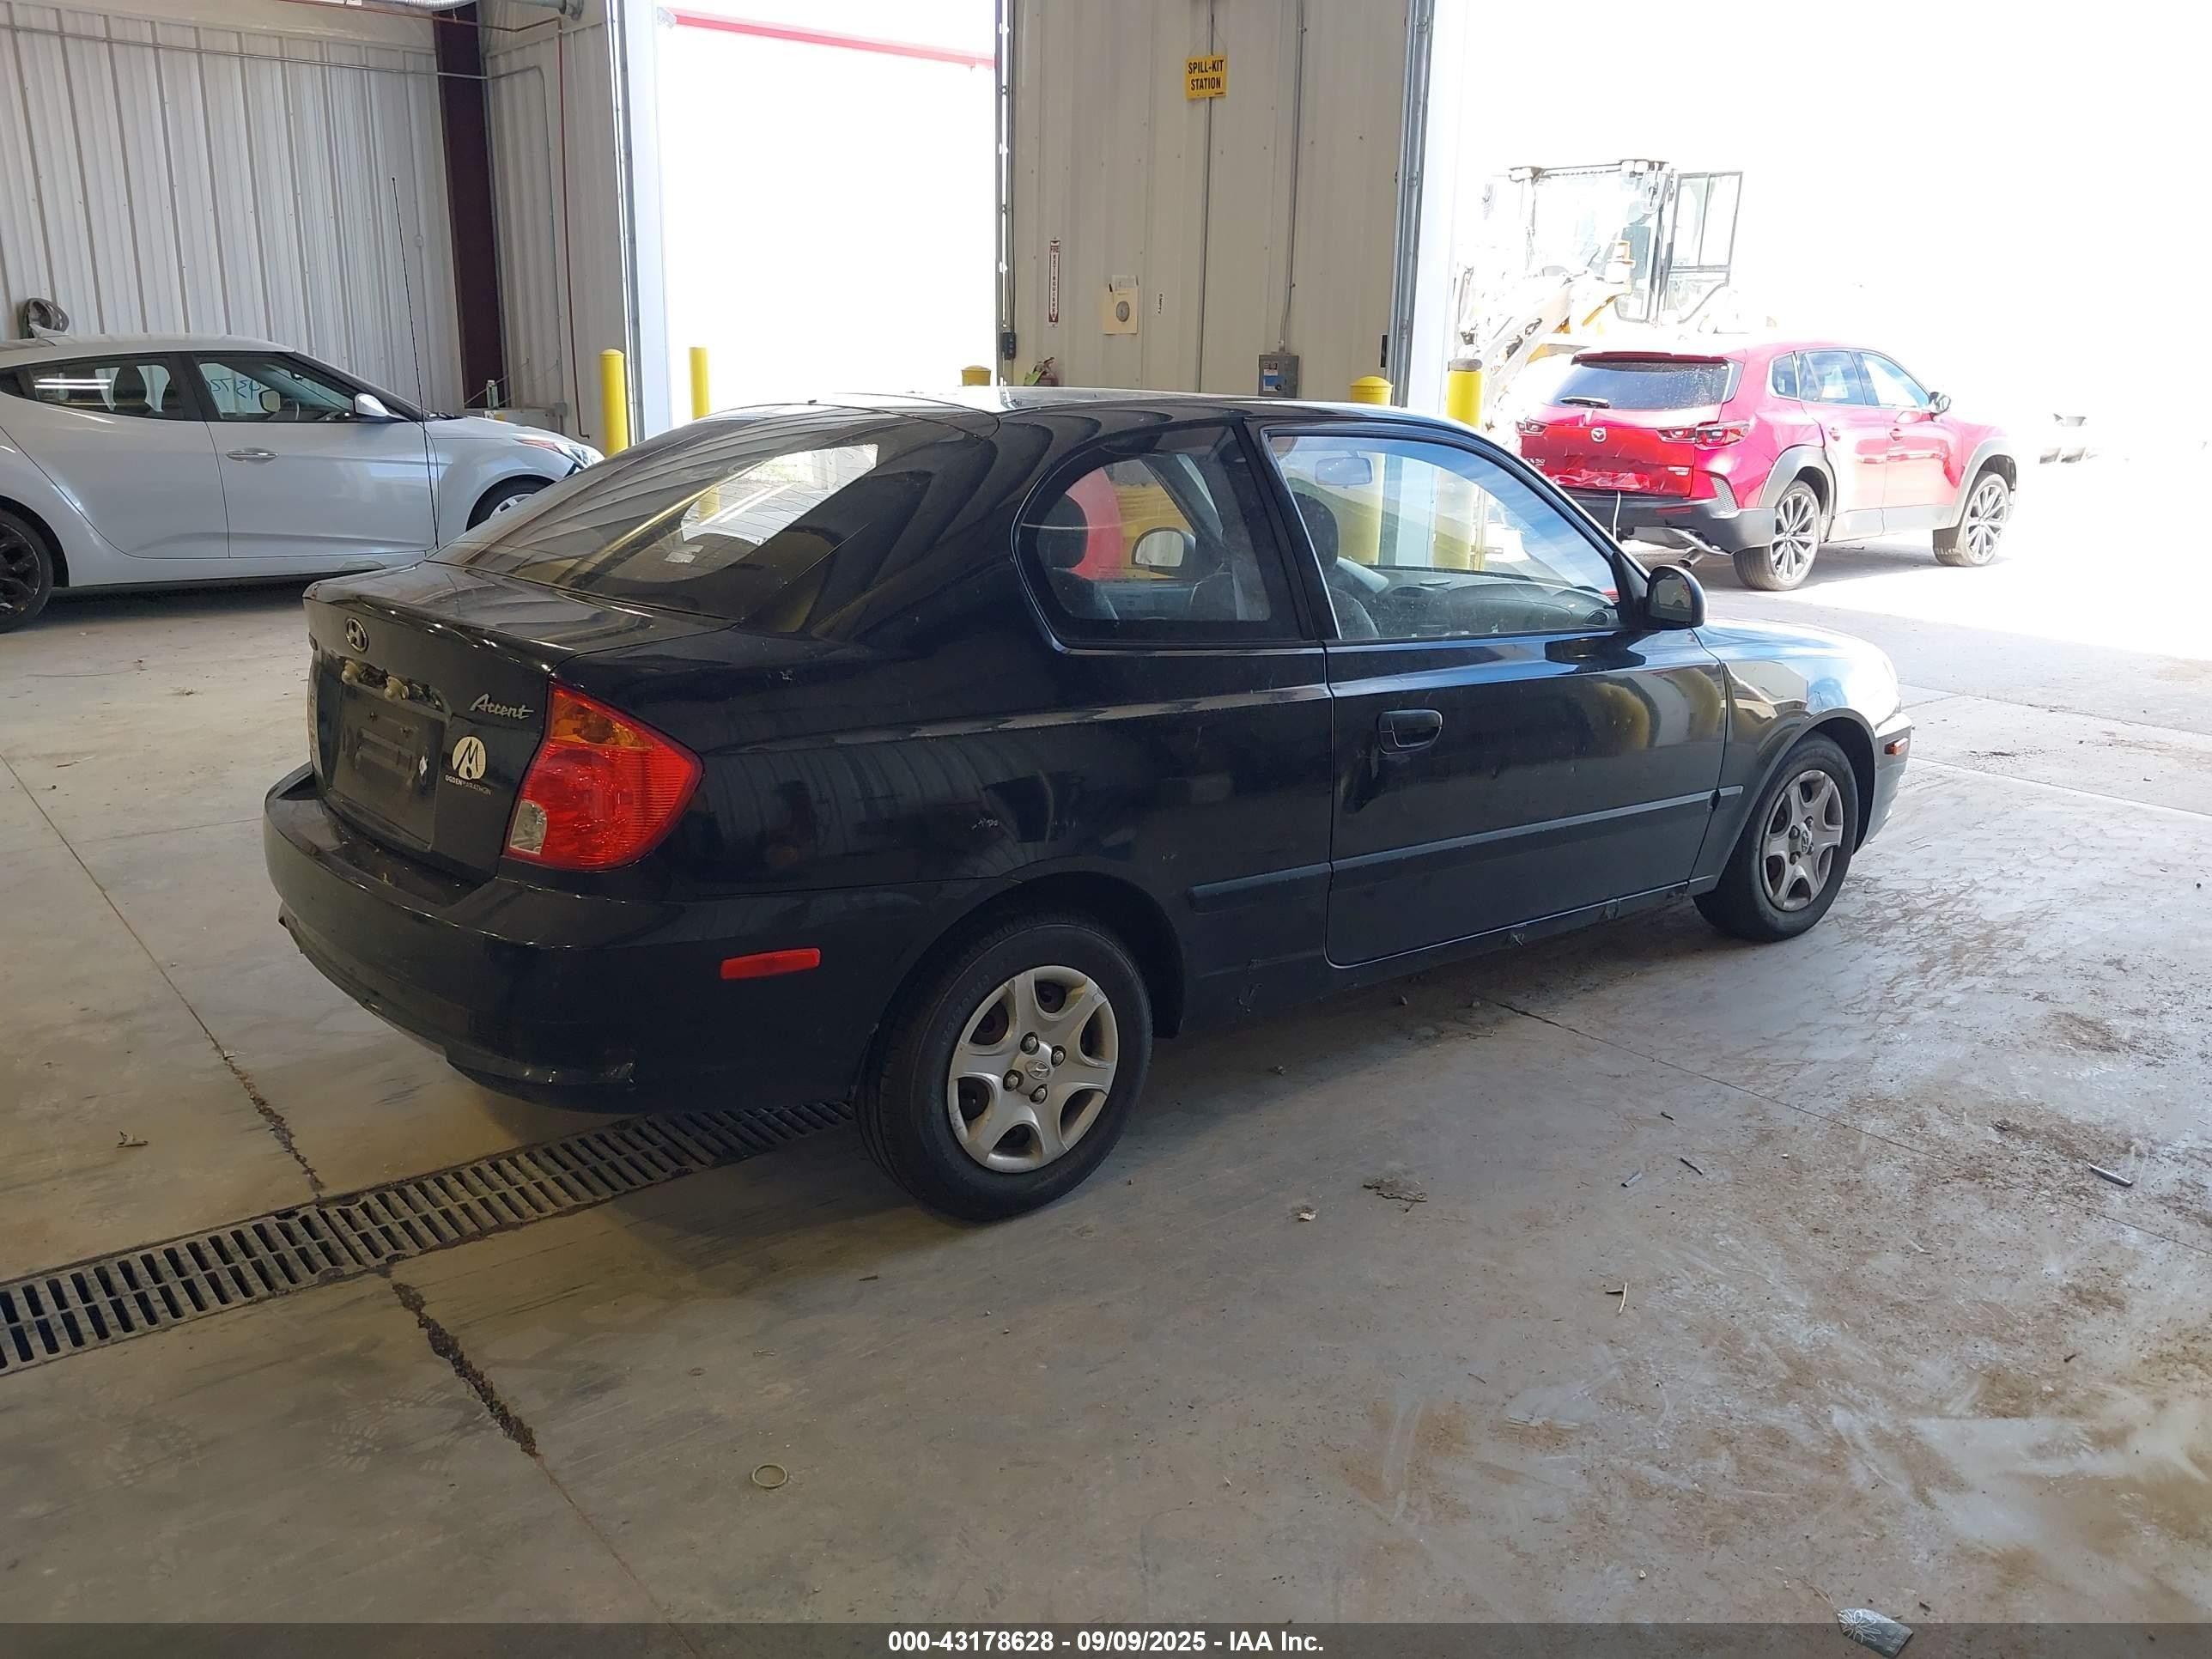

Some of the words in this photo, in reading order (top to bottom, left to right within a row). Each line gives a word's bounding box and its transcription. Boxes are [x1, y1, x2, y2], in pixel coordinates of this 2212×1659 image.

[1188, 59, 1224, 75] SPILL-KIT
[1190, 76, 1221, 91] STATION
[470, 694, 534, 719] Accent
